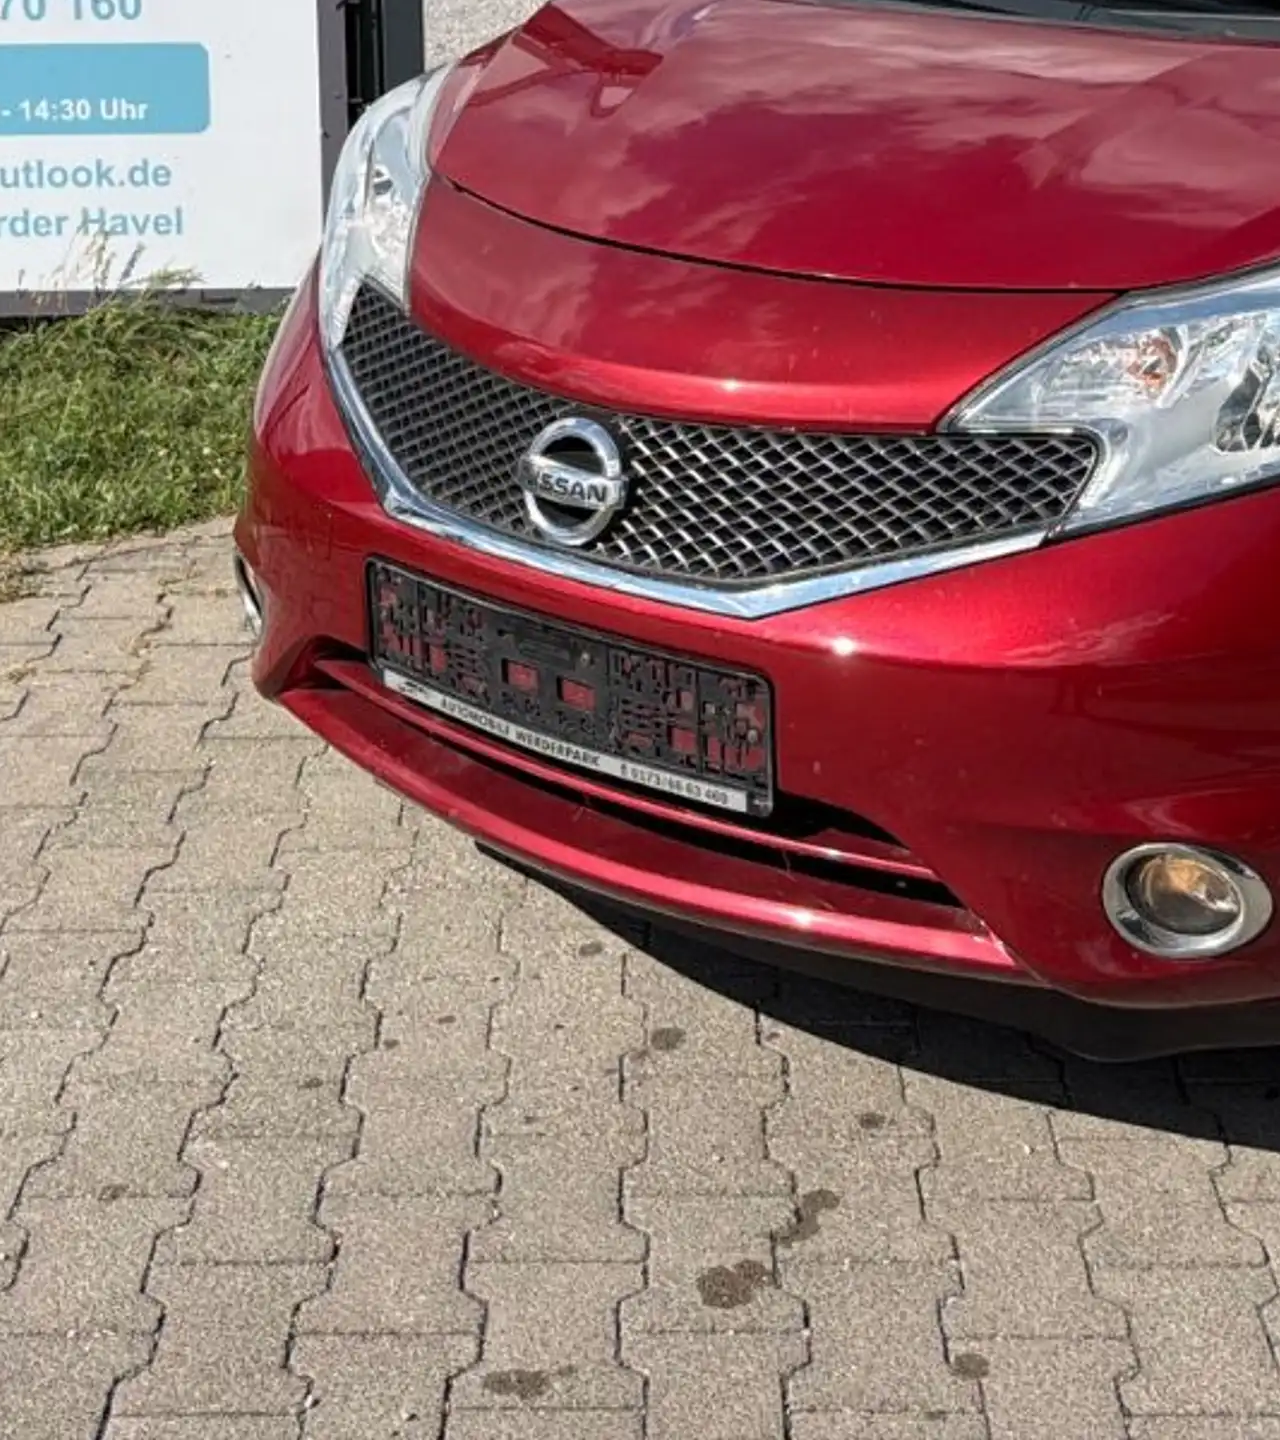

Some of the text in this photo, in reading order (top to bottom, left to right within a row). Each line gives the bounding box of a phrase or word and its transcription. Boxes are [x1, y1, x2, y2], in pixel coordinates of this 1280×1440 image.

[20, 99, 91, 122] 14:30
[99, 98, 149, 121] Uhr
[78, 205, 184, 237] Havel
